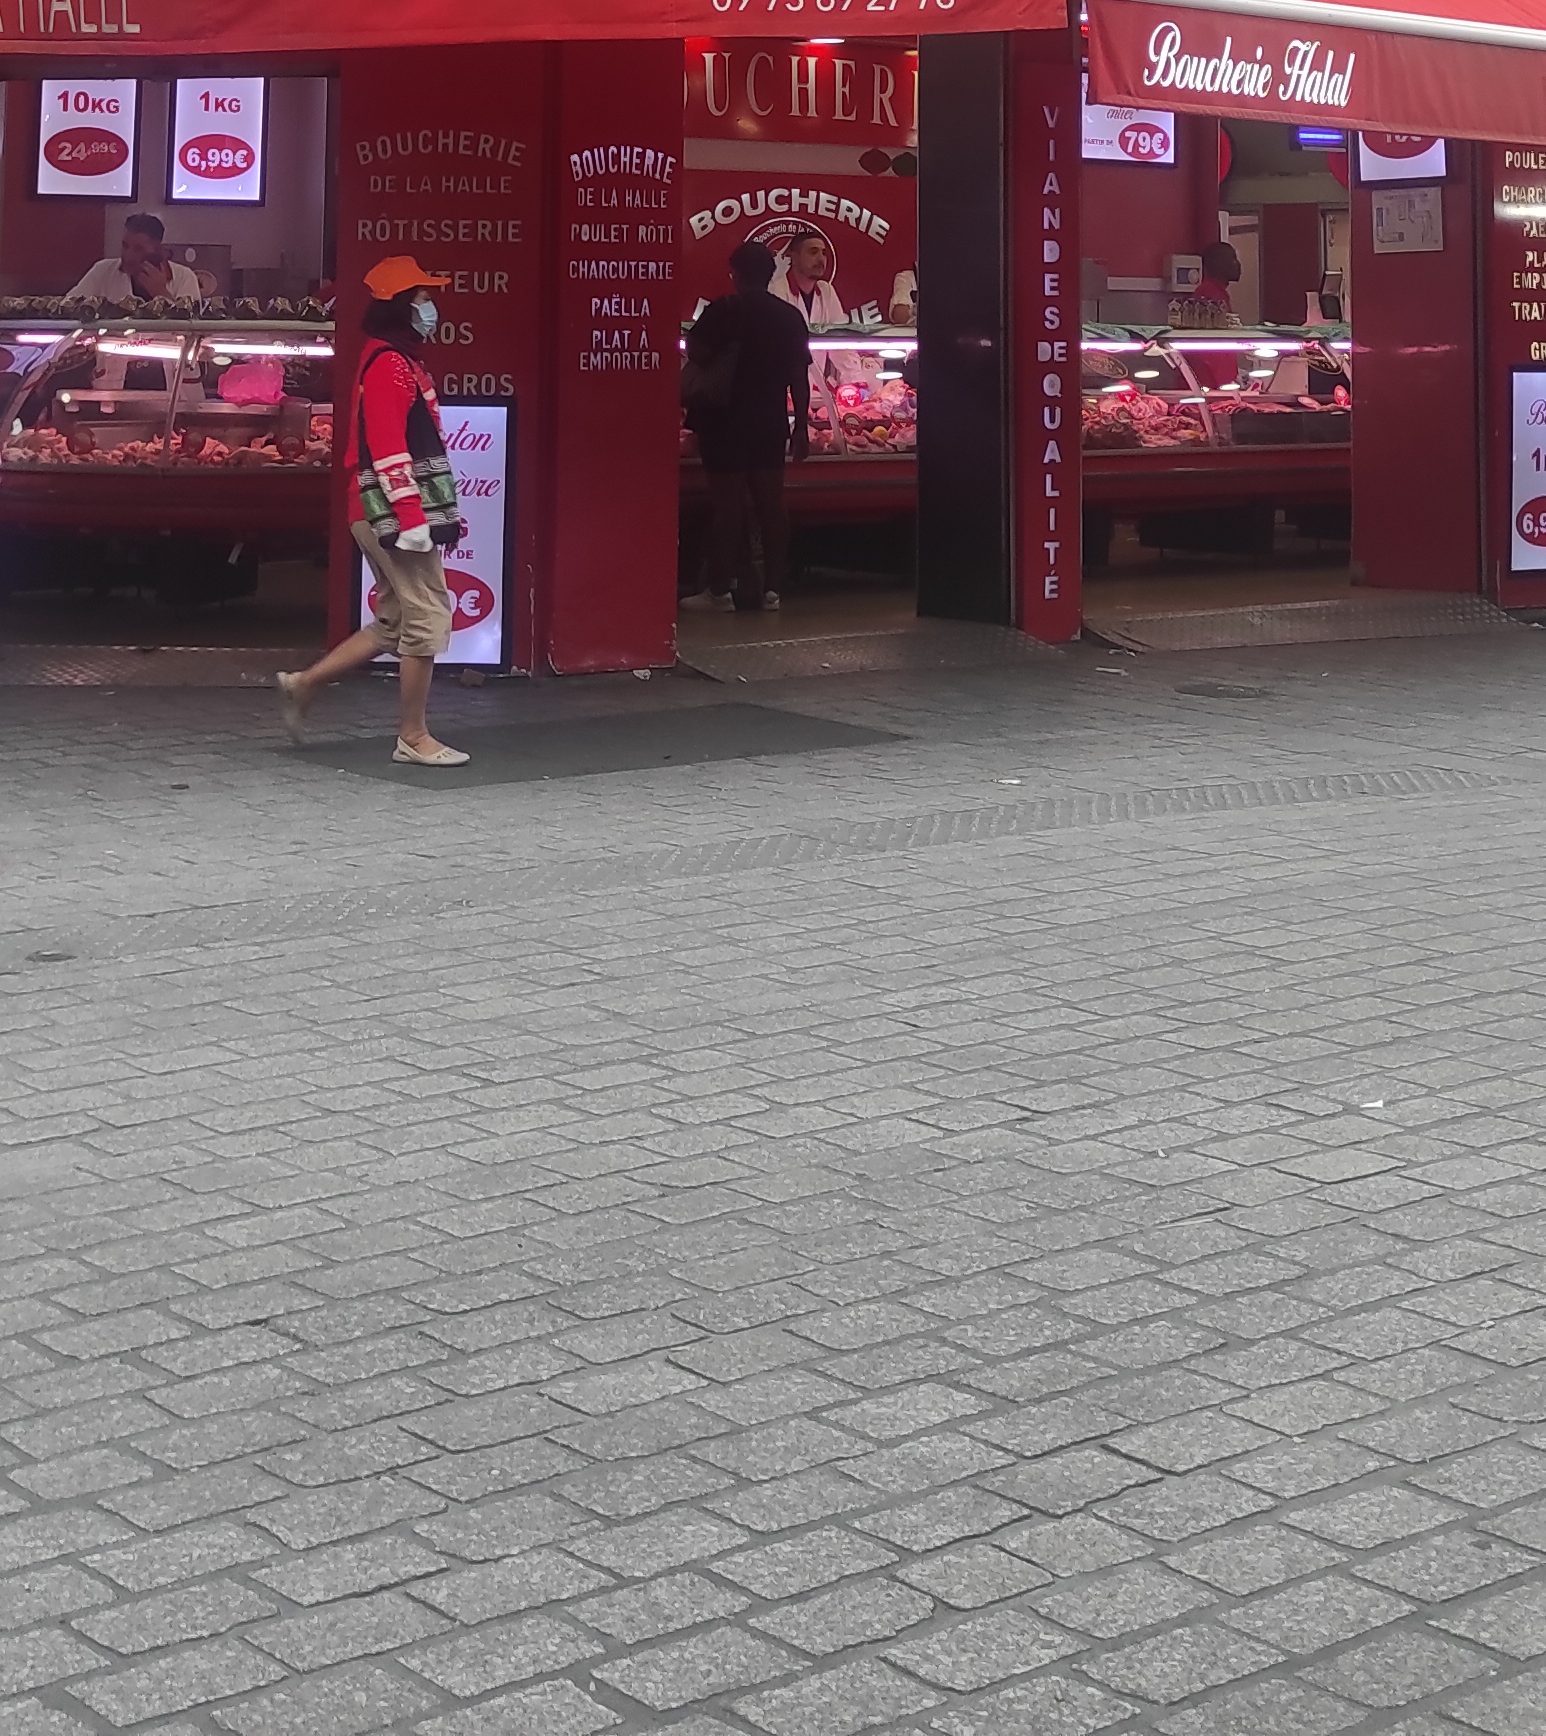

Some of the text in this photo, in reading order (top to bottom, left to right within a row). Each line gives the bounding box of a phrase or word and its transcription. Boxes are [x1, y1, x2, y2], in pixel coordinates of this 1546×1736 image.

[1143, 20, 1356, 108] Boucherie Halal
[57, 90, 120, 114] 10KG
[199, 90, 241, 113] 1KG
[684, 51, 918, 130] UCHER
[355, 130, 527, 167] BOUCHERIE
[1124, 130, 1165, 155] 79€
[186, 147, 249, 171] 6,99€
[569, 145, 677, 185] BOUCHERIE
[369, 175, 512, 194] DE LA HALLE
[577, 187, 668, 209] DE LA HALLE
[357, 213, 522, 243] RÔTISSERIE
[688, 187, 891, 246] BOUCHERIE
[1042, 105, 1061, 330] VIANDES
[570, 220, 674, 244] POULET RÔTI
[569, 260, 674, 281] CHARCUTERIE
[591, 293, 651, 318] PAËLLA
[592, 324, 649, 351] PLAT À
[579, 351, 661, 371] EMPORTER
[1038, 341, 1068, 362] DE
[443, 373, 514, 397] GROS
[443, 420, 494, 452] uton
[455, 470, 501, 498] èvre
[1042, 371, 1063, 601] QUALITÉ
[456, 549, 474, 560] DE
